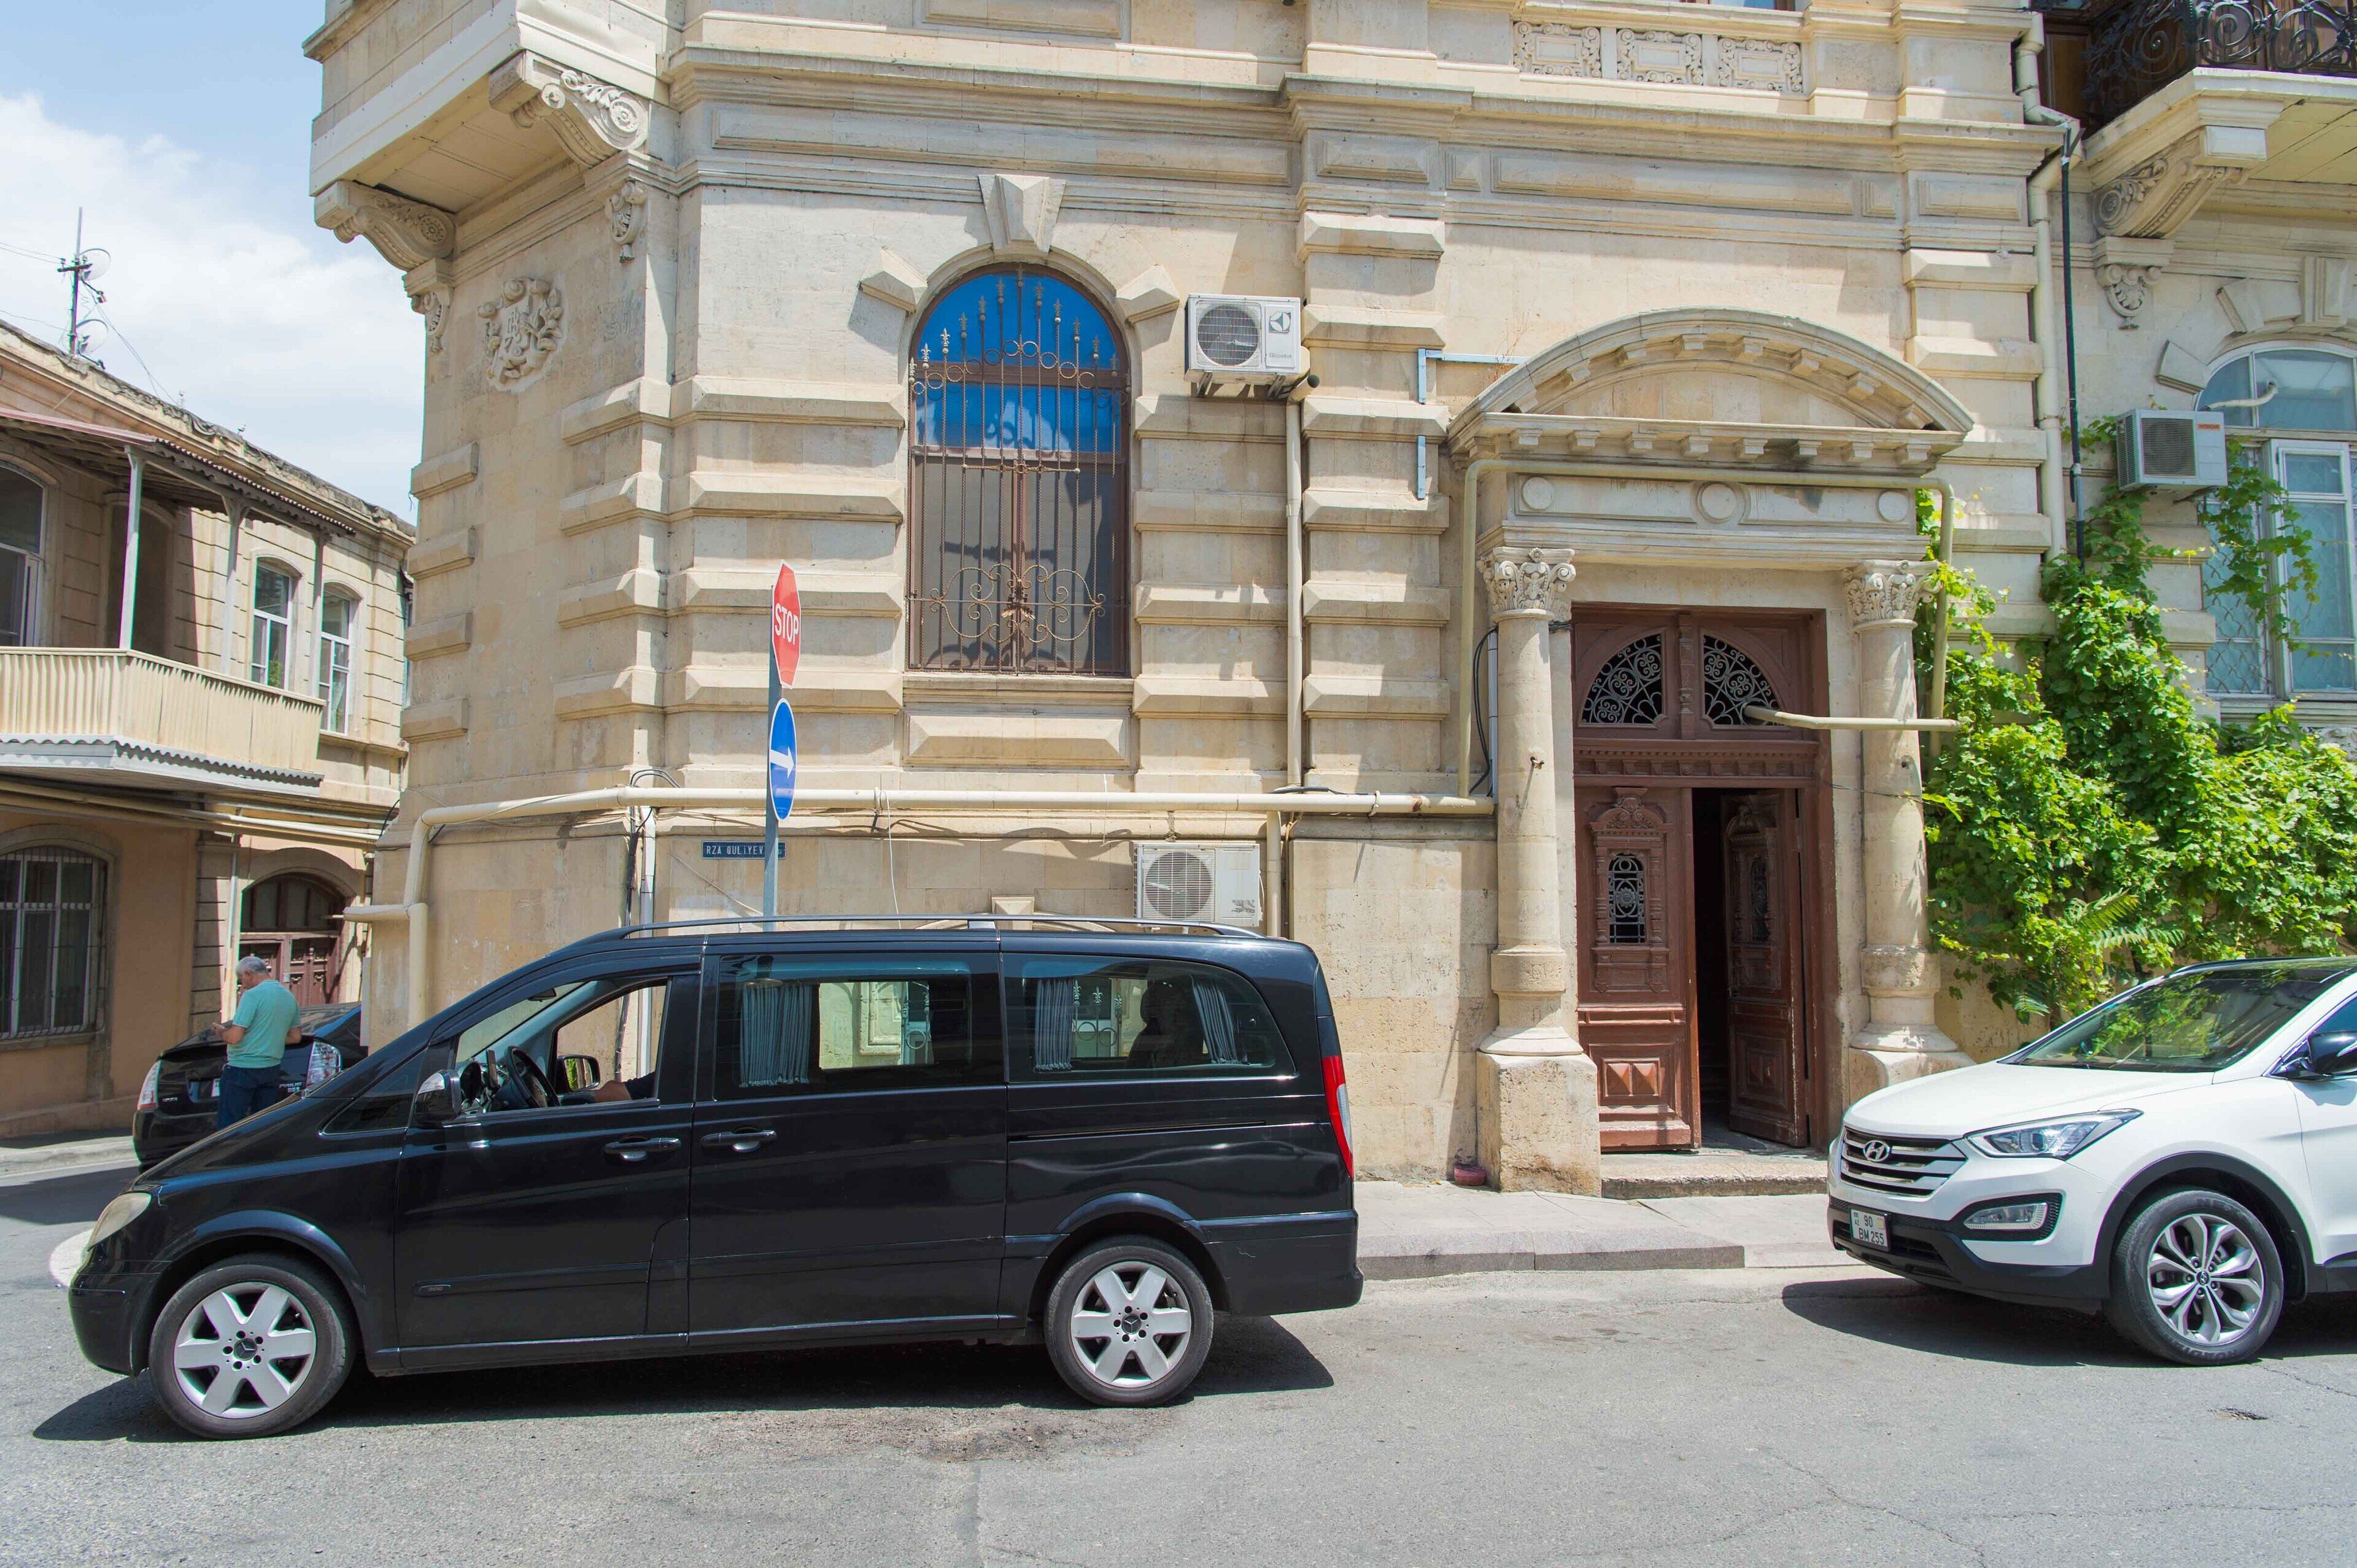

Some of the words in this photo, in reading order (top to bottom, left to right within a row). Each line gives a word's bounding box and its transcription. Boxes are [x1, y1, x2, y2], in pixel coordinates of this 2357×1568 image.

[775, 603, 799, 645] STOP
[706, 845, 721, 855] RZA
[1864, 1215, 1873, 1228] 90
[1859, 1227, 1870, 1241] BM
[1870, 1230, 1885, 1245] 255
